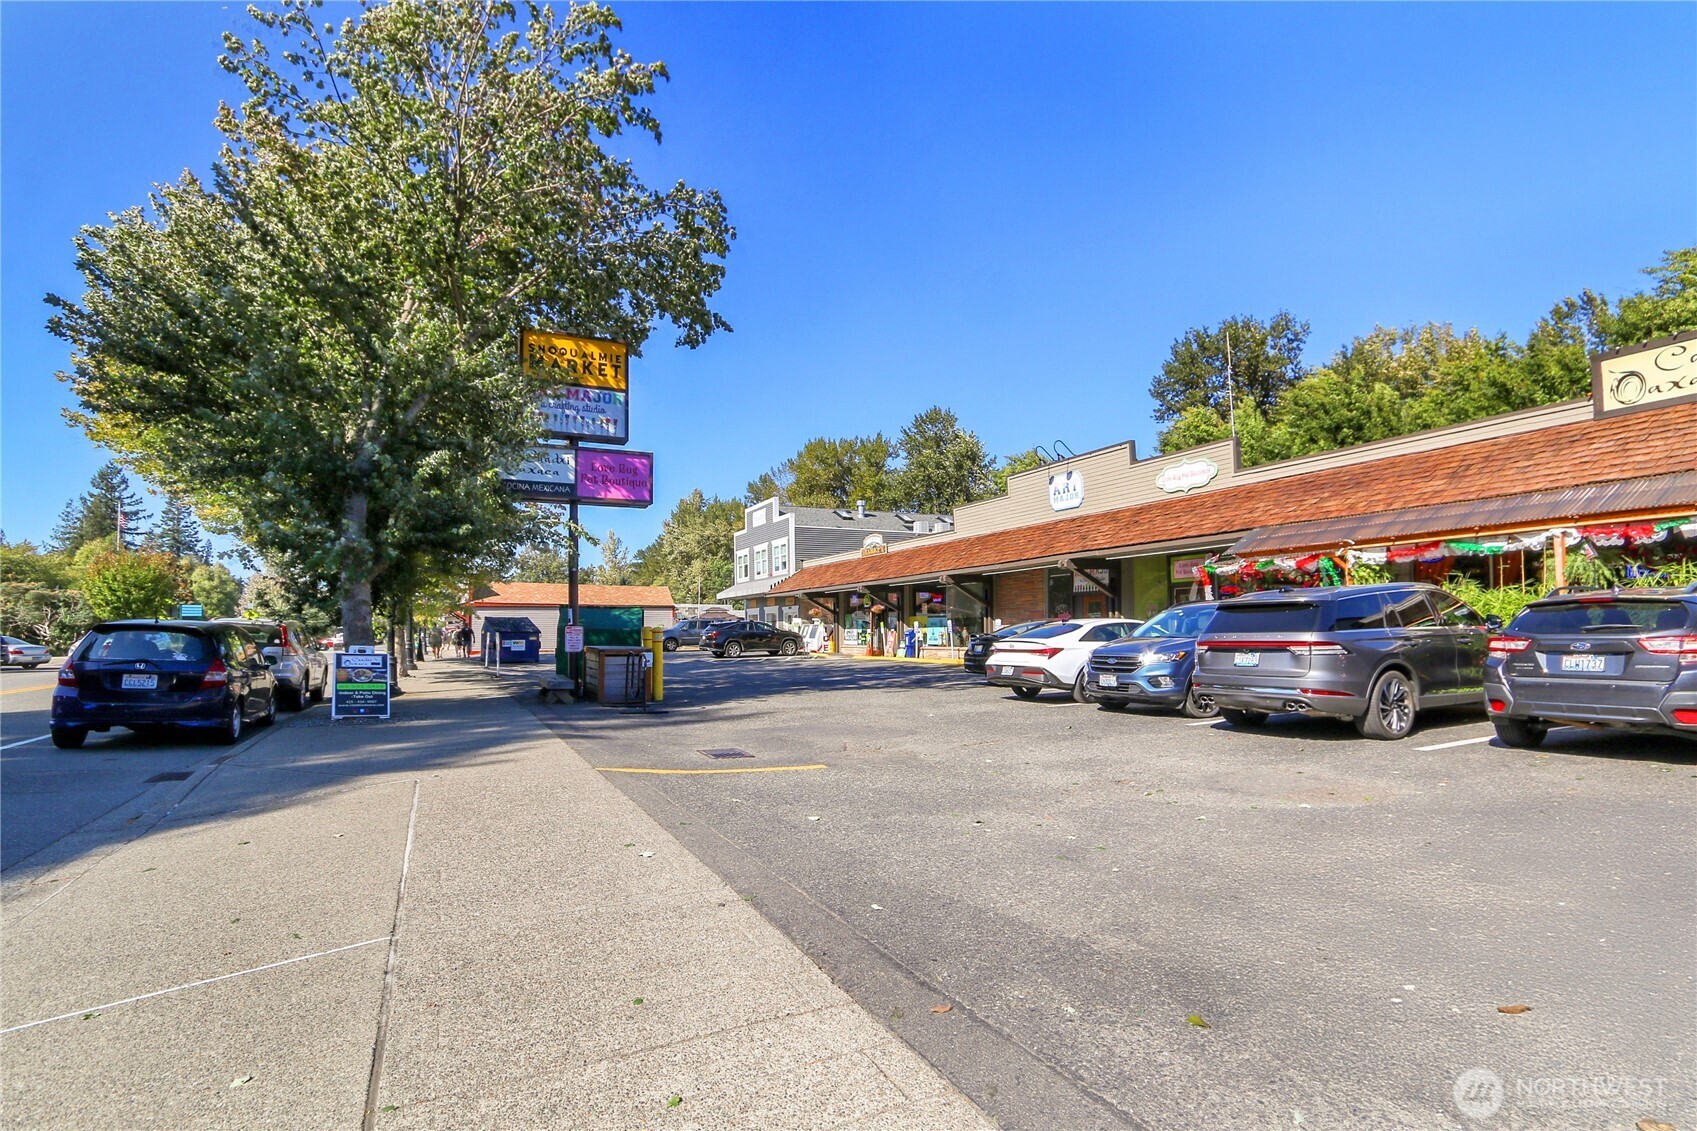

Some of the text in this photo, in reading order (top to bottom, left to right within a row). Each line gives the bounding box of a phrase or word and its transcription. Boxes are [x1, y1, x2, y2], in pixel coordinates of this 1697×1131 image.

[528, 343, 622, 364] SNOQUALMIE
[591, 461, 638, 477] Love Bug
[504, 481, 570, 493] OCINA MEXICANA
[581, 473, 647, 489] Pet Boutique
